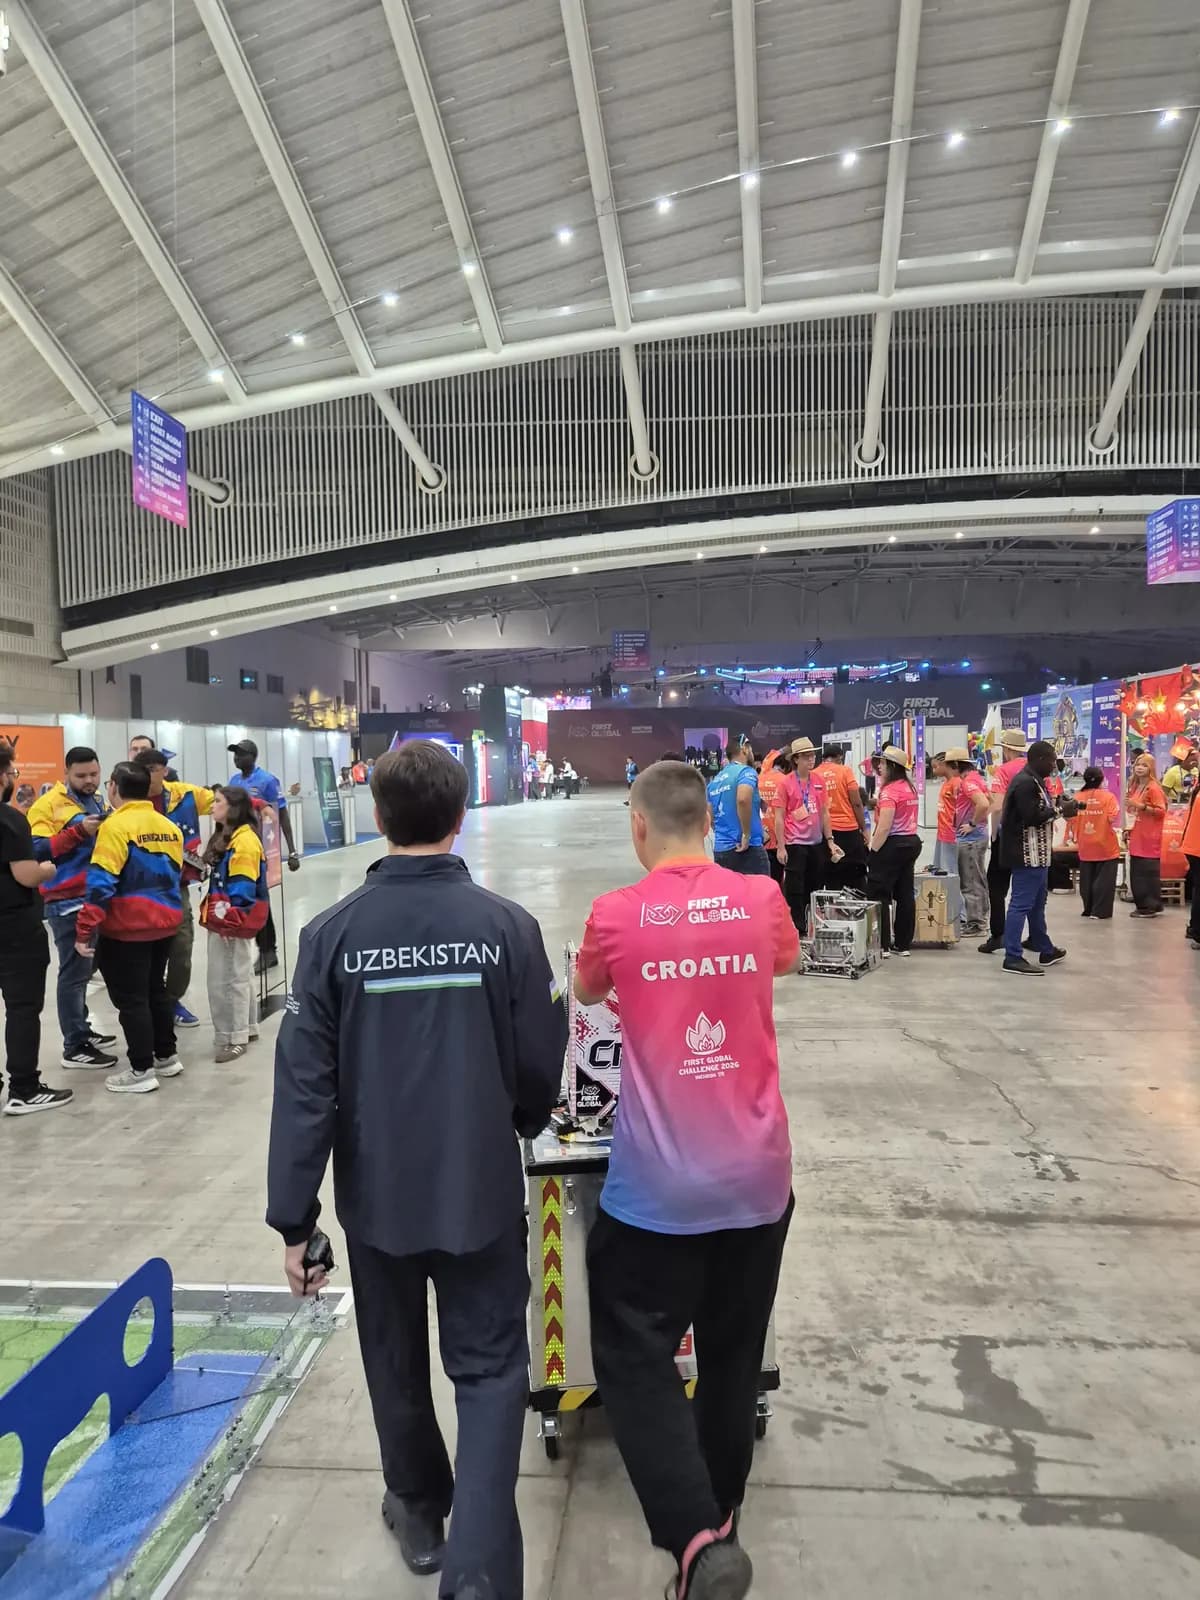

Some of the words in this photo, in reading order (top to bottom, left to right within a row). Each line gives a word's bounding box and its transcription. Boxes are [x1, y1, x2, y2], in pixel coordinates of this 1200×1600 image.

[151, 410, 164, 426] EXIT
[166, 431, 182, 449] ROOM
[903, 697, 939, 708] FIRST
[903, 707, 954, 719] GLOBAL
[687, 896, 729, 910] FIRST
[687, 907, 751, 924] GLOBAL
[344, 943, 500, 973] UZBEKISTAN
[641, 953, 758, 981] CROATIA
[684, 1057, 705, 1067] FIRST
[706, 1054, 734, 1064] GLOBAL
[679, 1063, 720, 1076] CHALLENGE
